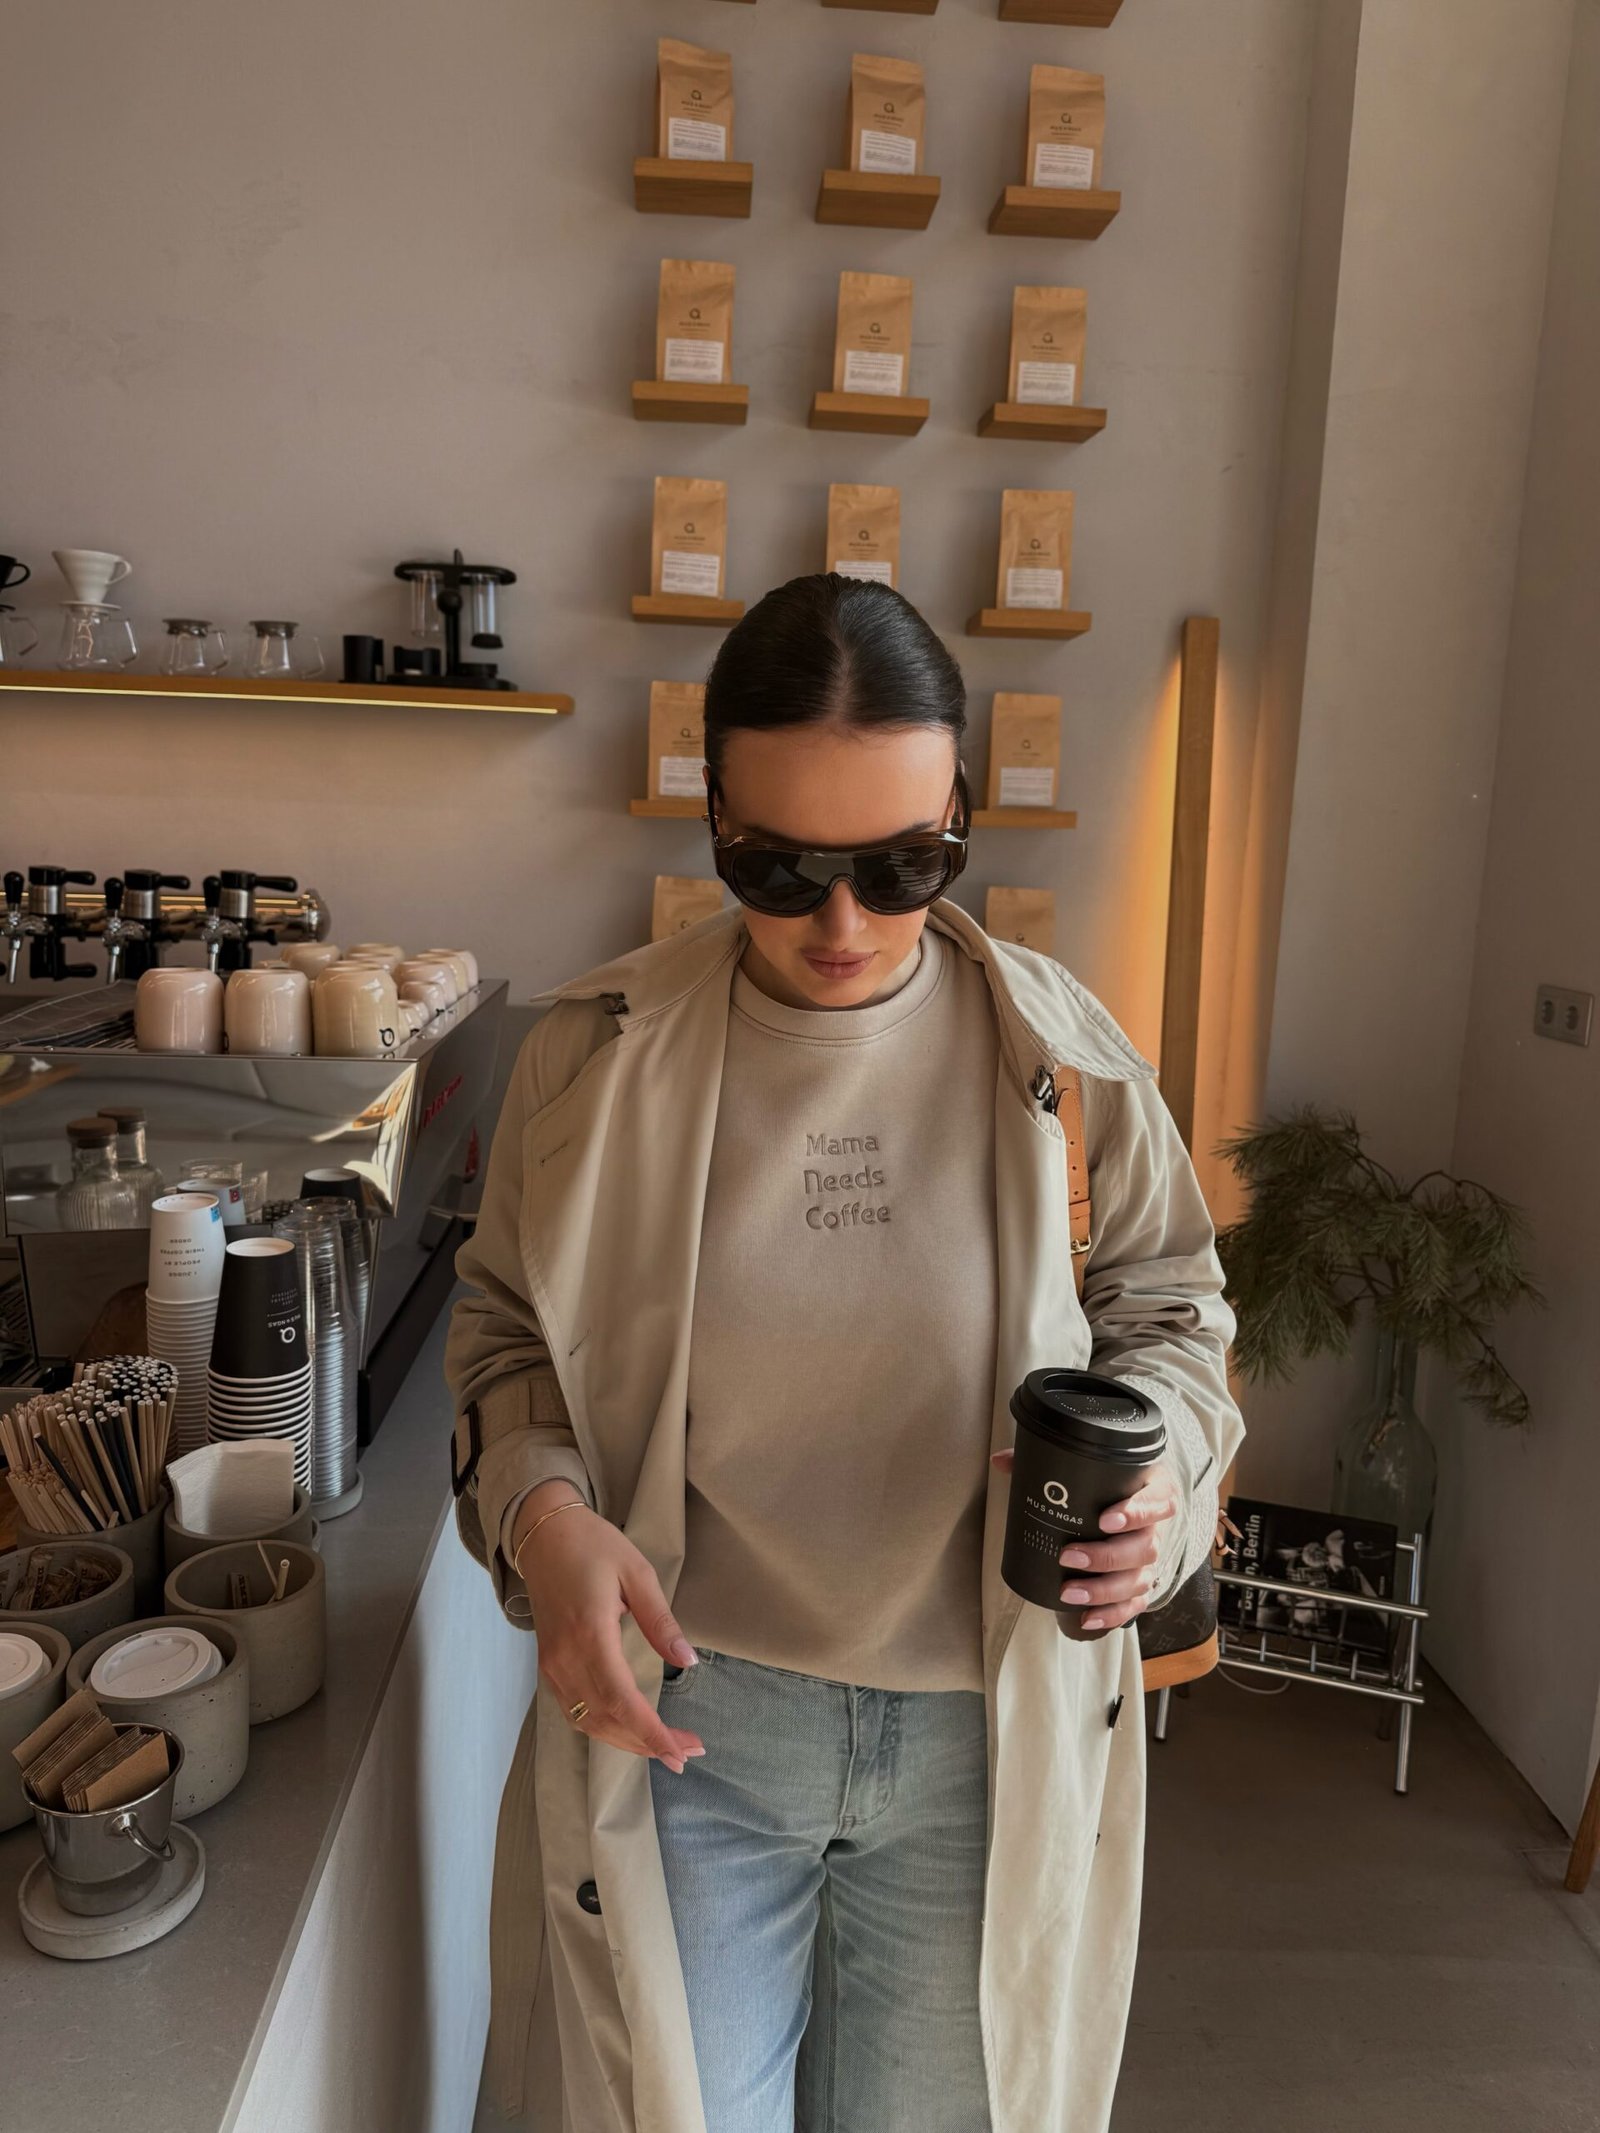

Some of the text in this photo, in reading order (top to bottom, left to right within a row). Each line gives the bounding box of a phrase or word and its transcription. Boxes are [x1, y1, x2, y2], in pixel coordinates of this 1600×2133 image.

[806, 1133, 879, 1156] Mama
[805, 1202, 891, 1230] Coffee
[1056, 1512, 1083, 1525] NGAS
[1243, 1514, 1261, 1559] Berlin
